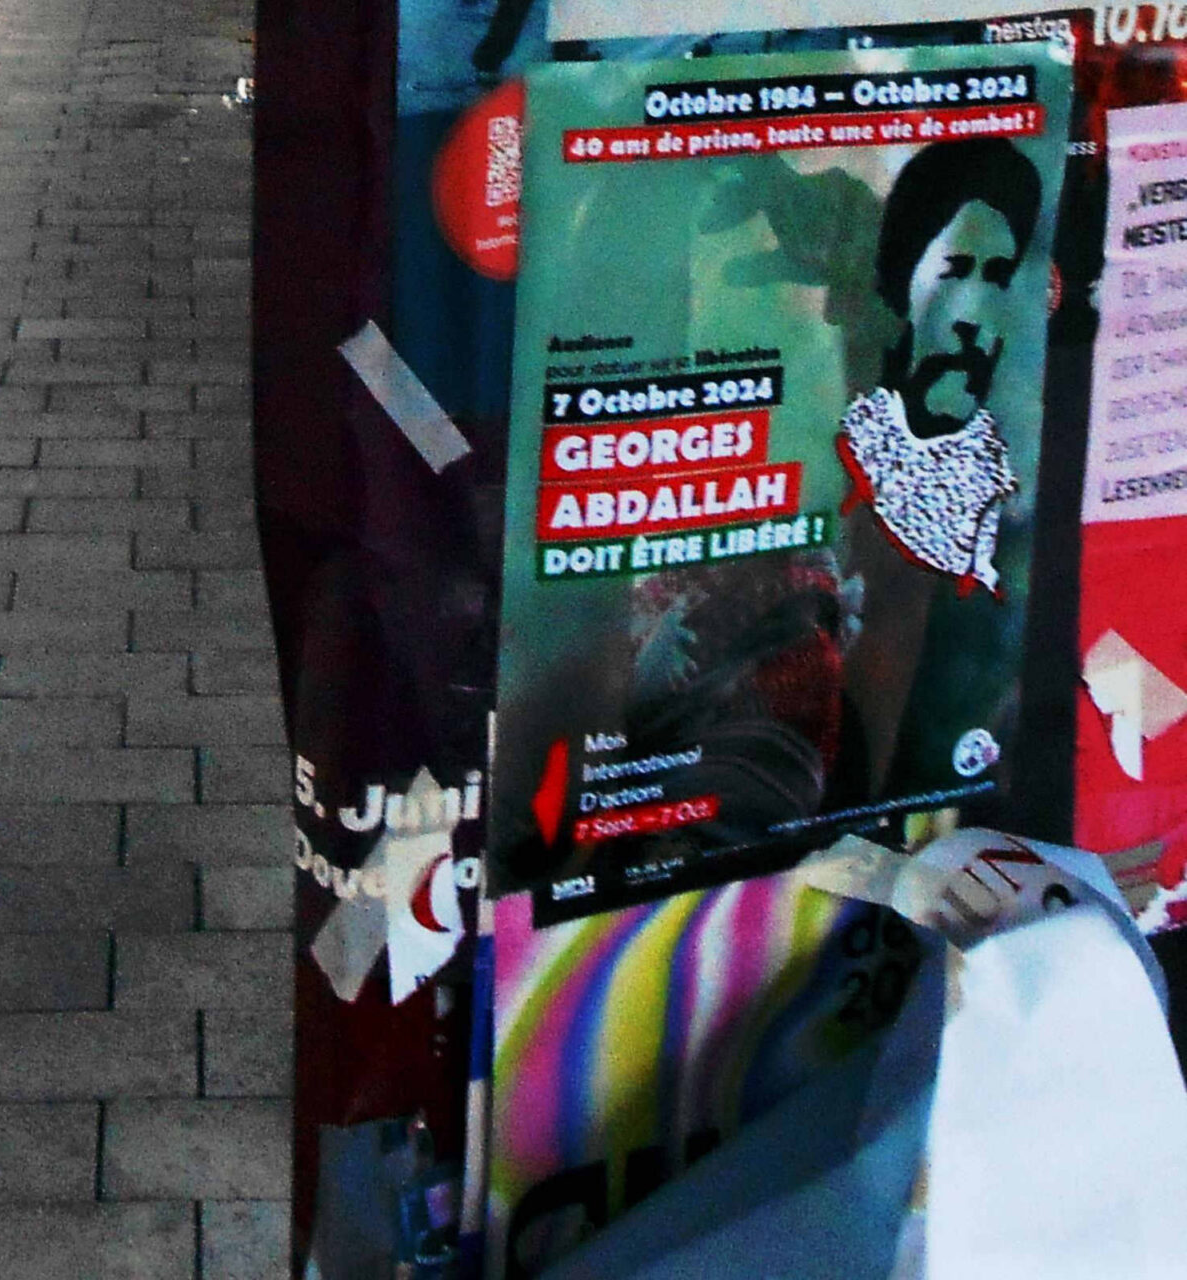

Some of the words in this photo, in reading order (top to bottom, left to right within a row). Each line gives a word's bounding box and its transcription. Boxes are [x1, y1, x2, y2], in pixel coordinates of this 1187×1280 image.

[645, 87, 753, 118] Octobre
[759, 84, 816, 111] 1984
[852, 76, 960, 106] Octobre
[966, 74, 1027, 100] 2024
[570, 137, 604, 156] 40
[610, 138, 650, 155] ans
[656, 132, 683, 153] de
[688, 128, 762, 156] prison,
[767, 121, 824, 144] toute
[830, 123, 874, 141] une
[879, 119, 913, 139] vie
[918, 116, 945, 137] de
[552, 393, 571, 417] 7
[577, 384, 696, 415] Octobre
[702, 377, 774, 406] 2024
[554, 421, 753, 472] GEORGES
[549, 473, 787, 529] ABDALLAH
[543, 544, 624, 574] DOIT
[629, 535, 704, 569] ÊTRE
[296, 754, 326, 818] 5.
[339, 769, 482, 832] Juni
